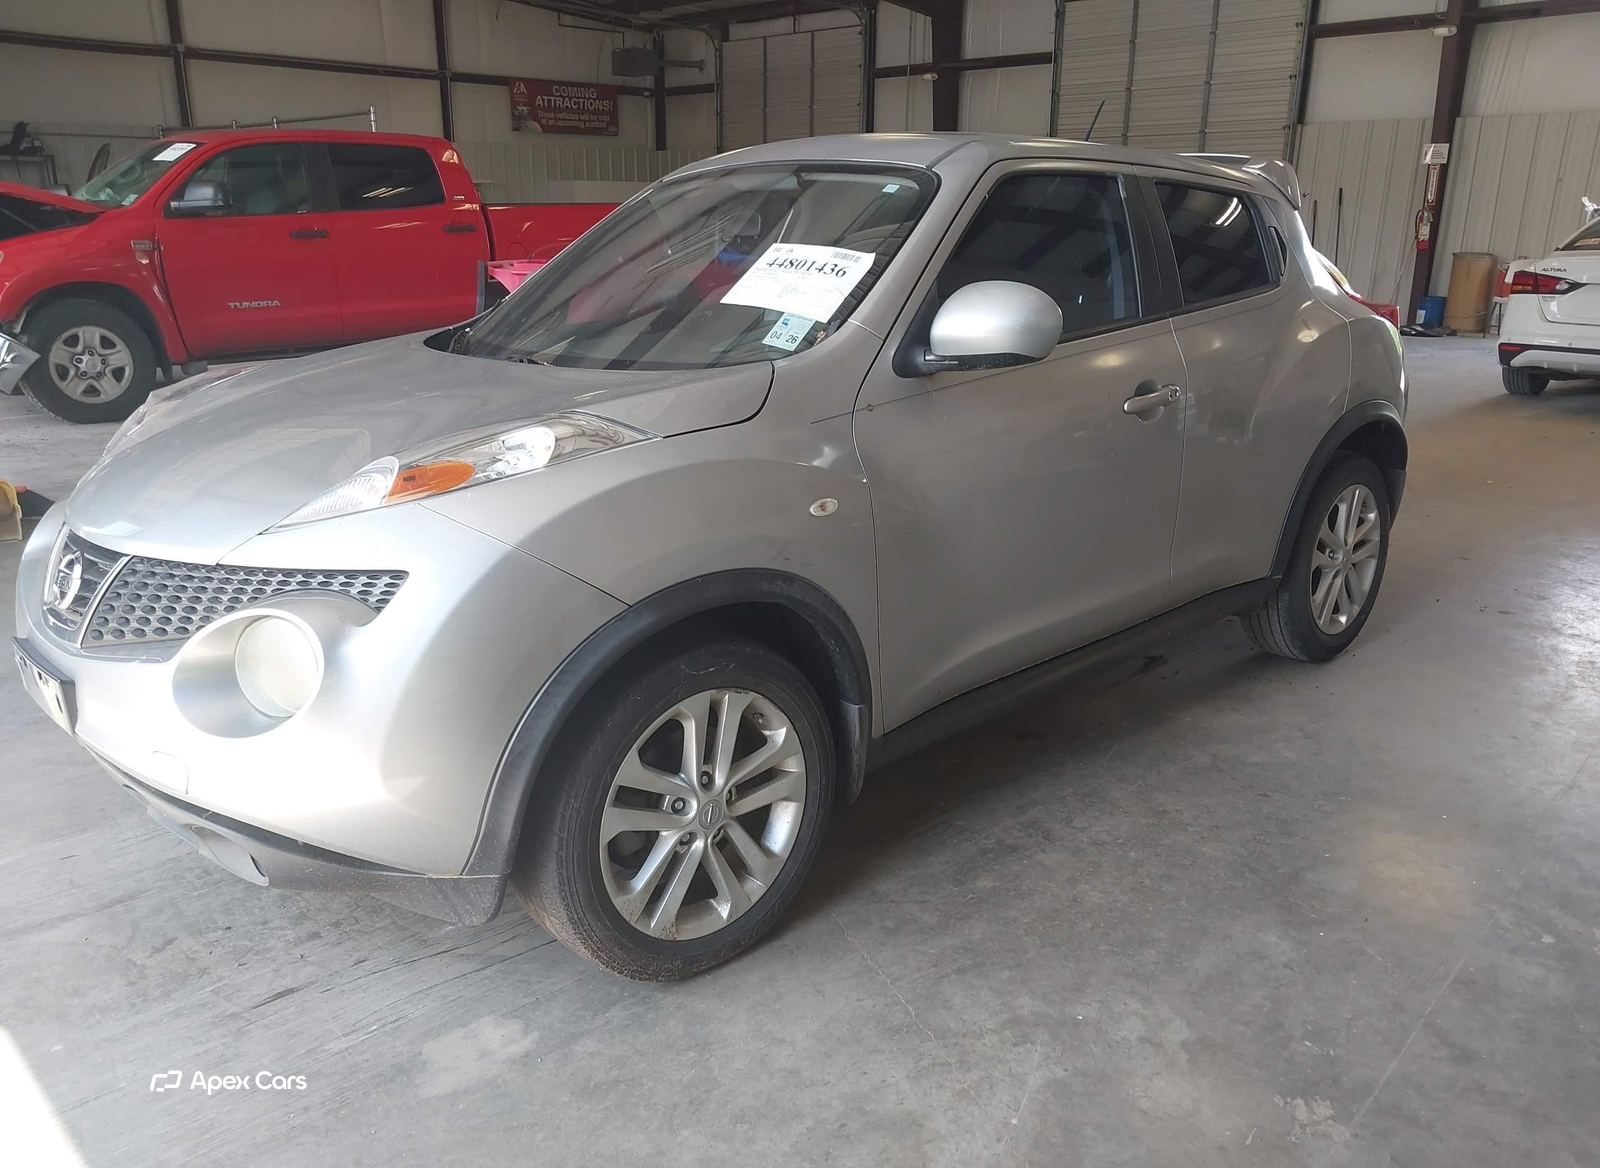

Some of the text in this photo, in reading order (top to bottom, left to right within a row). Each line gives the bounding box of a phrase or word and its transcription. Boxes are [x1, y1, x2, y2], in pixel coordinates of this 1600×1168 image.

[552, 85, 597, 99] COMING
[535, 95, 613, 111] ATTRACTIONS!
[556, 111, 579, 120] vehicles
[579, 112, 589, 120] will
[556, 119, 585, 129] upcoming
[766, 256, 849, 278] 44801436
[227, 300, 281, 309] TUNDRA
[770, 330, 799, 345] 04 26
